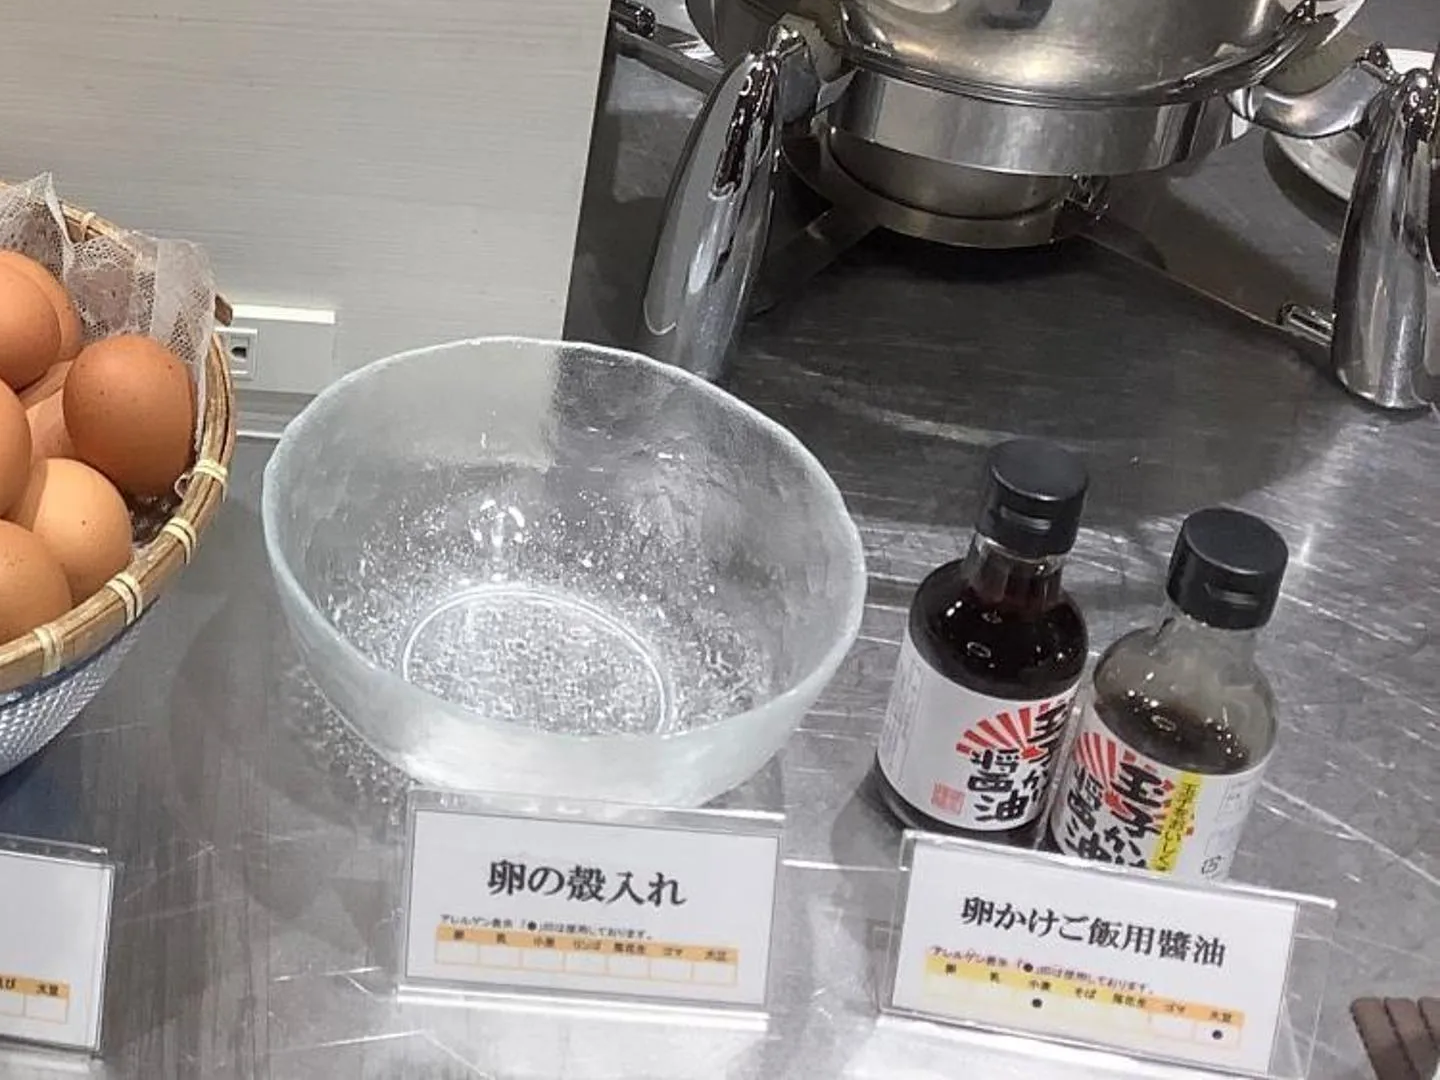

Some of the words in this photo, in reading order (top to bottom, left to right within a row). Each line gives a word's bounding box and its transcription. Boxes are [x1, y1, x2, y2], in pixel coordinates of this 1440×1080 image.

[487, 859, 687, 907] 卵の殻入れ
